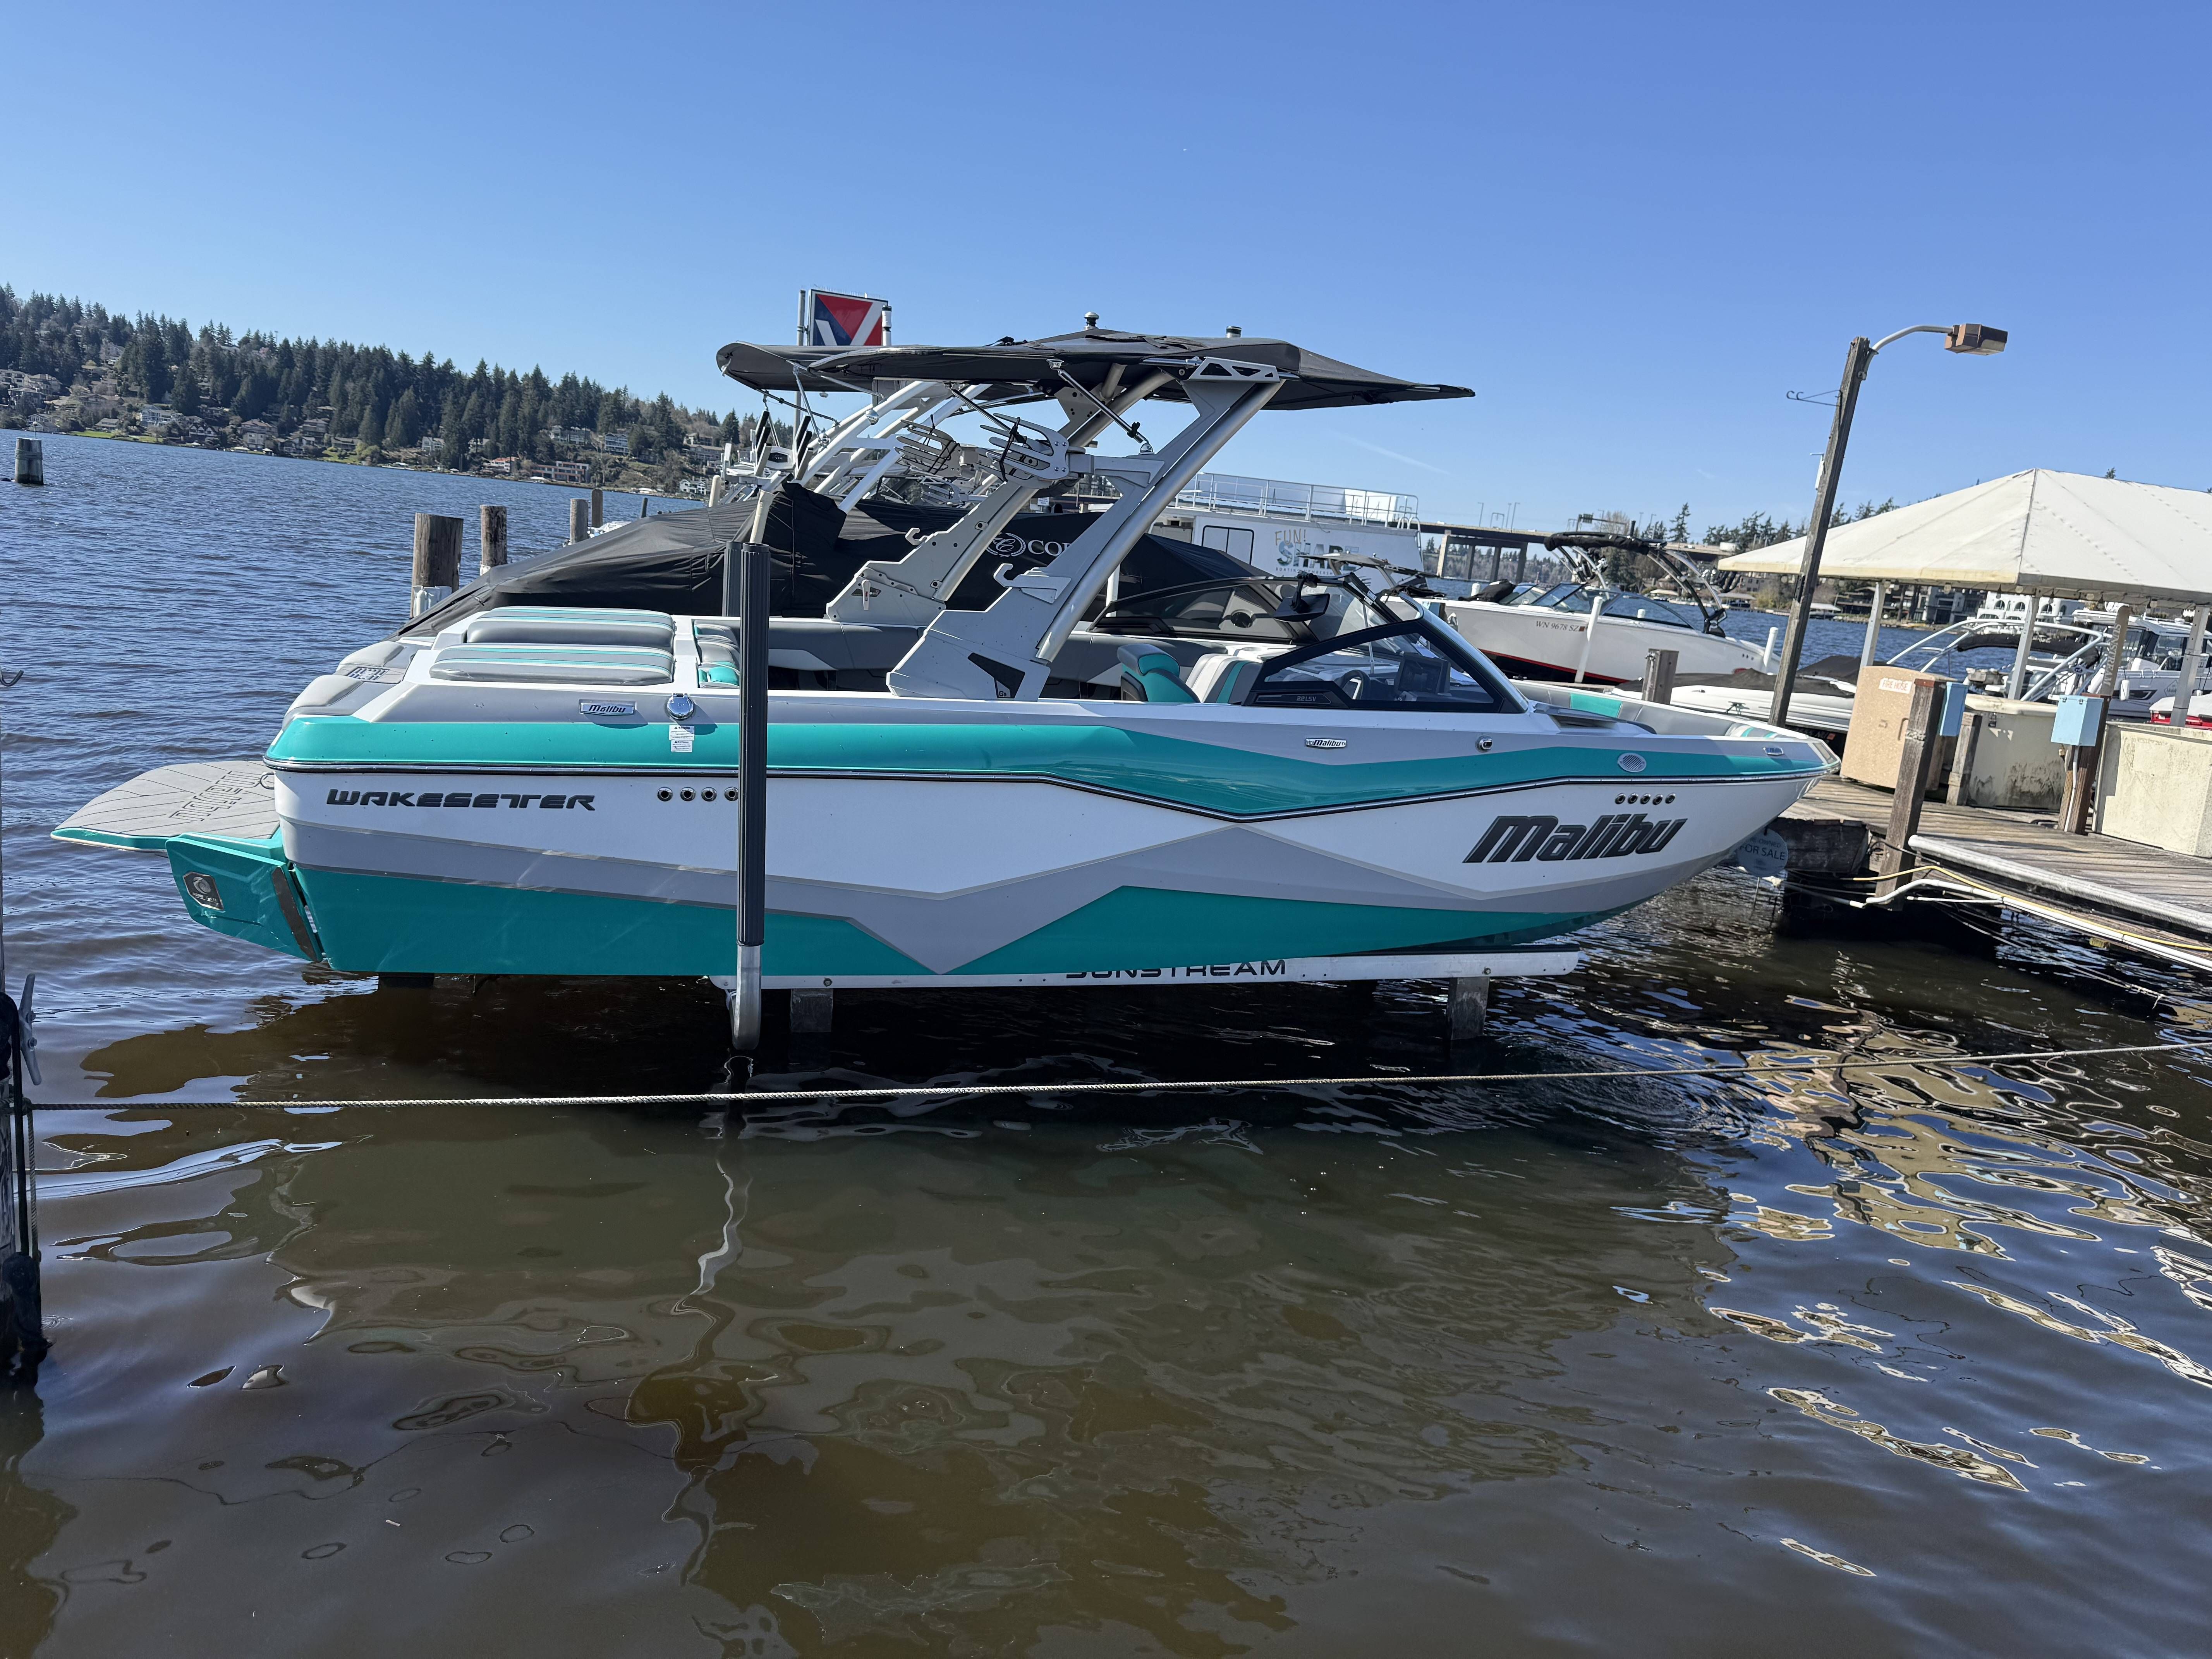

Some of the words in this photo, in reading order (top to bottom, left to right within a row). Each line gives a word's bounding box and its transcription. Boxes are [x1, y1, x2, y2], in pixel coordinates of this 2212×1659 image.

[1275, 528, 1306, 546] FUN!
[1277, 541, 1359, 571] SHARE
[2103, 623, 2121, 686] SUNSTREAM
[1882, 680, 1893, 689] FIRE
[1894, 682, 1908, 690] HOSE
[589, 705, 626, 713] Malibu
[326, 788, 596, 811] WAKESETTER
[1462, 813, 1688, 863] Malibu
[1762, 847, 1785, 860] SALE
